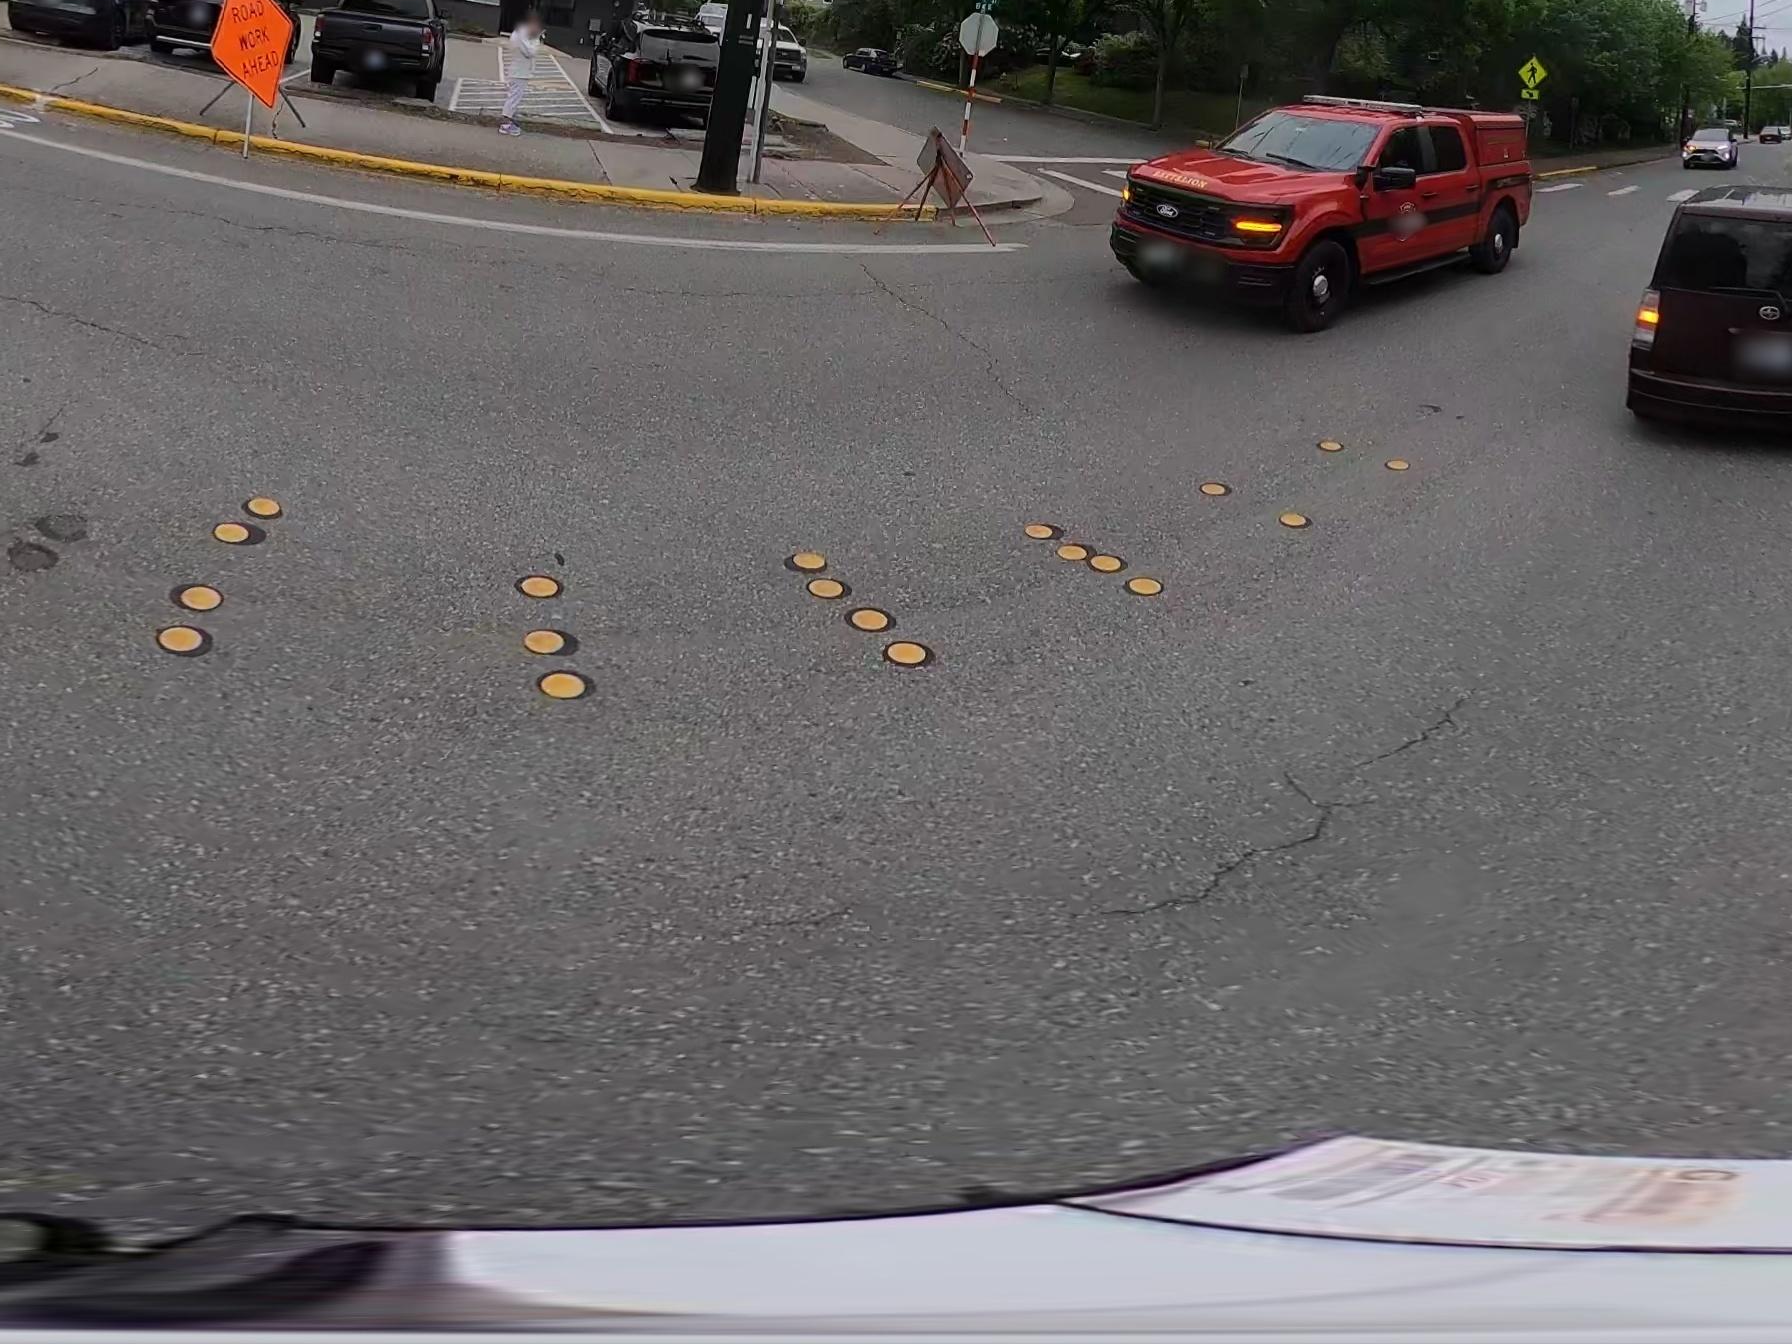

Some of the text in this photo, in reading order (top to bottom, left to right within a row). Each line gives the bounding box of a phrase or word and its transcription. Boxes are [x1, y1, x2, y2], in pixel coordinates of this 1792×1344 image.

[231, 0, 264, 23] ROAD
[239, 27, 270, 51] WORK
[242, 51, 279, 78] AHEAD
